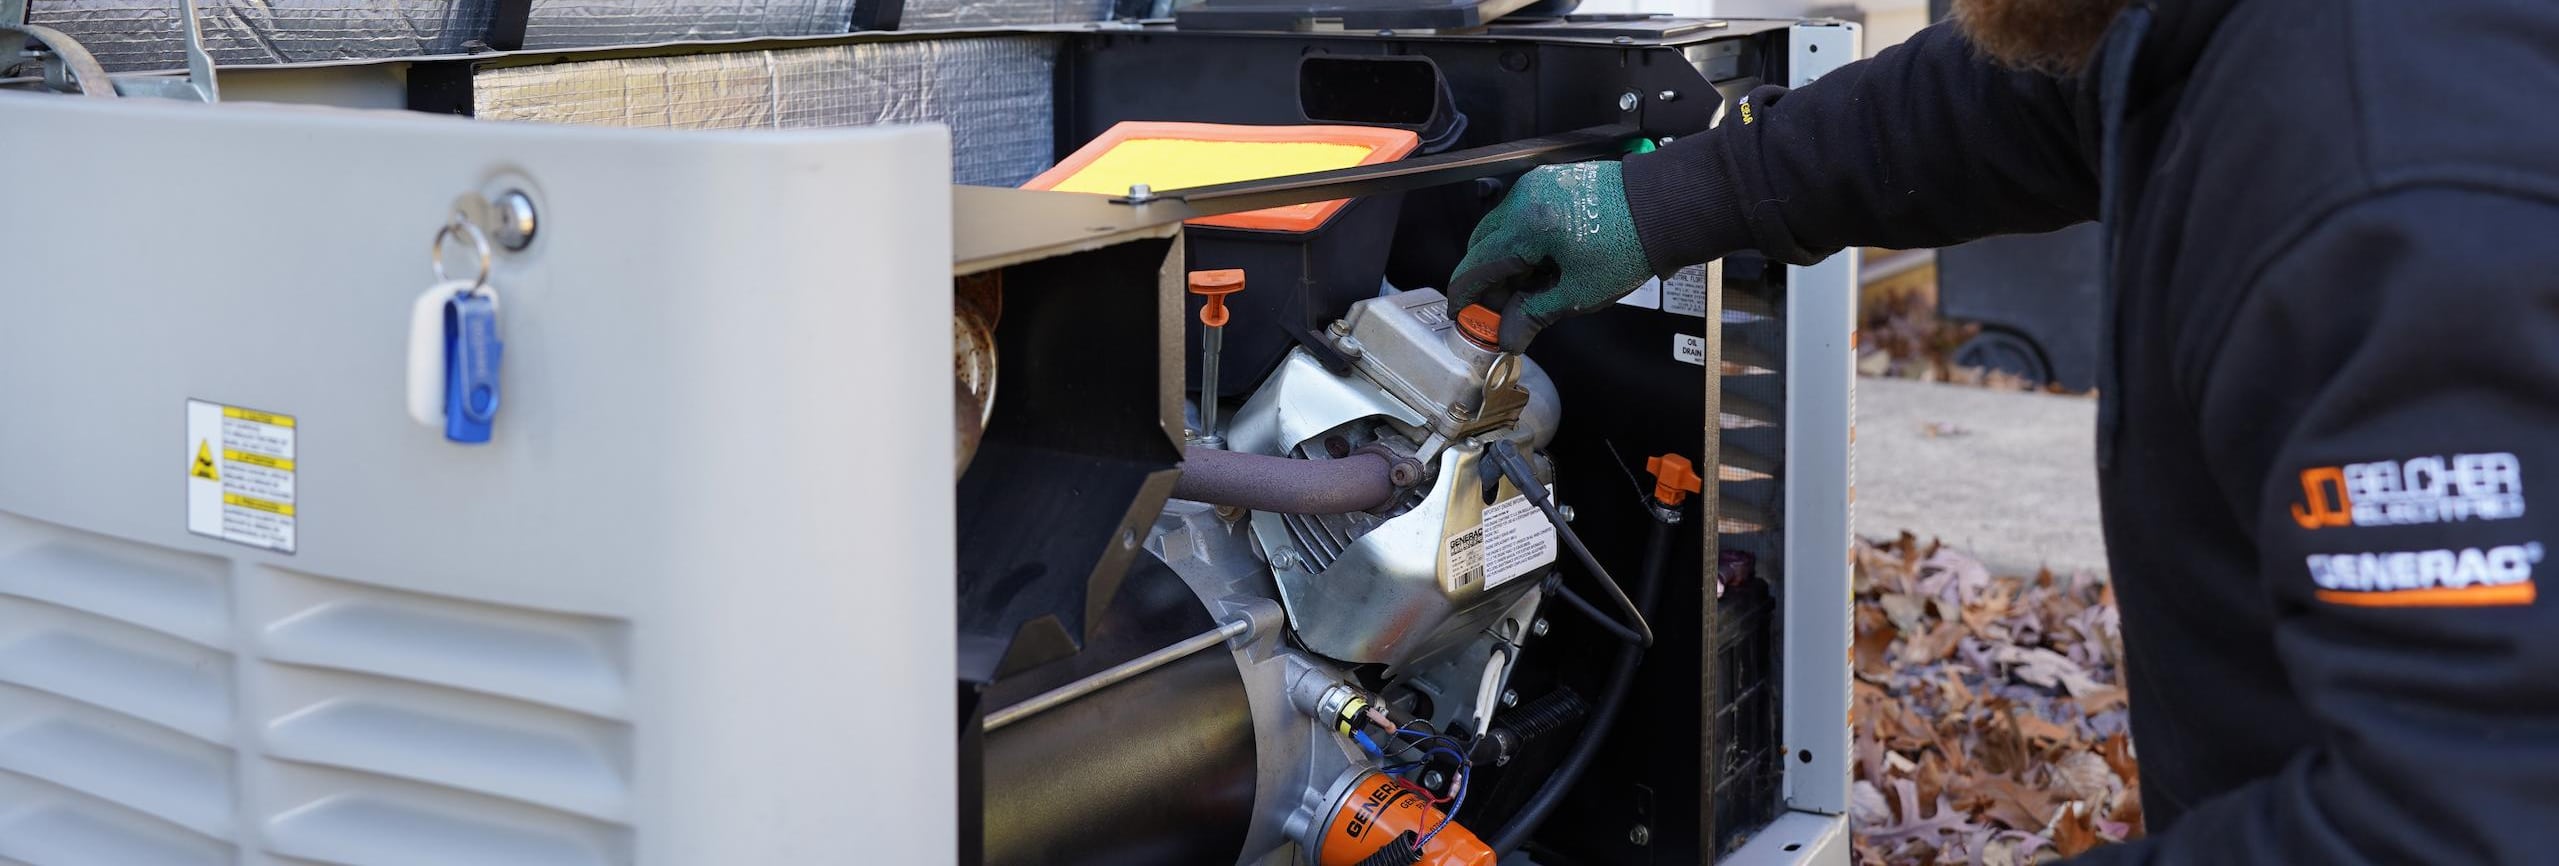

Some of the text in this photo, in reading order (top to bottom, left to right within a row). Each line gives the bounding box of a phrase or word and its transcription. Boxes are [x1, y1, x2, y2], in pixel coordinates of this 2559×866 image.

[1687, 338, 1697, 346] OIL
[1682, 346, 1702, 357] DRAIN
[2291, 452, 2523, 530] JD BELCHER
